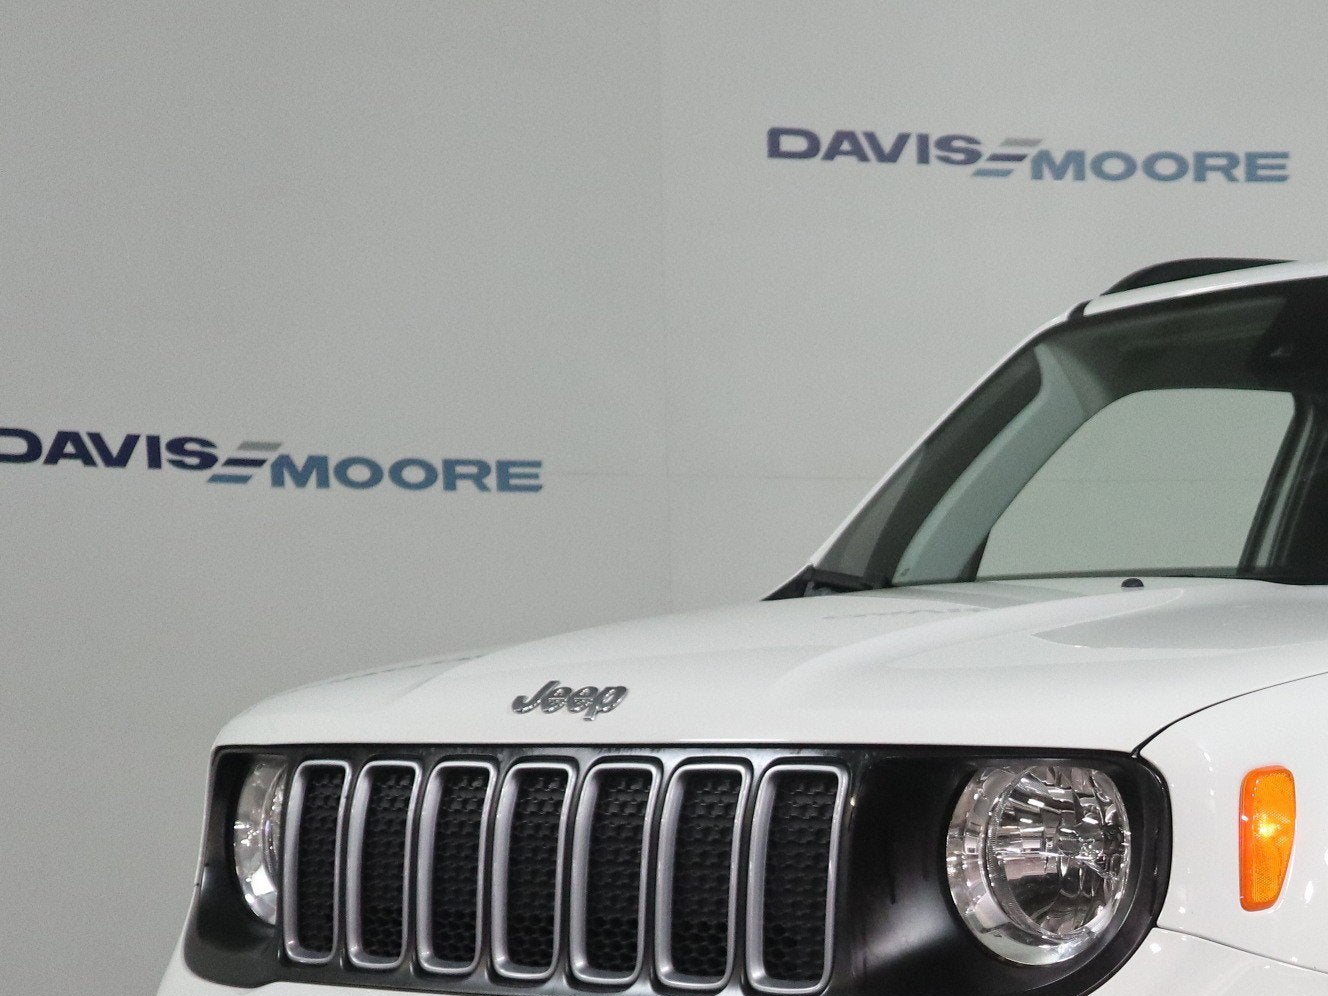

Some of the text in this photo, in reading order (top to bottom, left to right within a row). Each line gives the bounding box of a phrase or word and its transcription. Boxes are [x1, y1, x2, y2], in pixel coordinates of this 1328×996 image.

[766, 126, 1290, 183] DAVIS MOORE
[0, 428, 543, 493] DAVIS MOORE
[511, 680, 628, 721] Jeep
